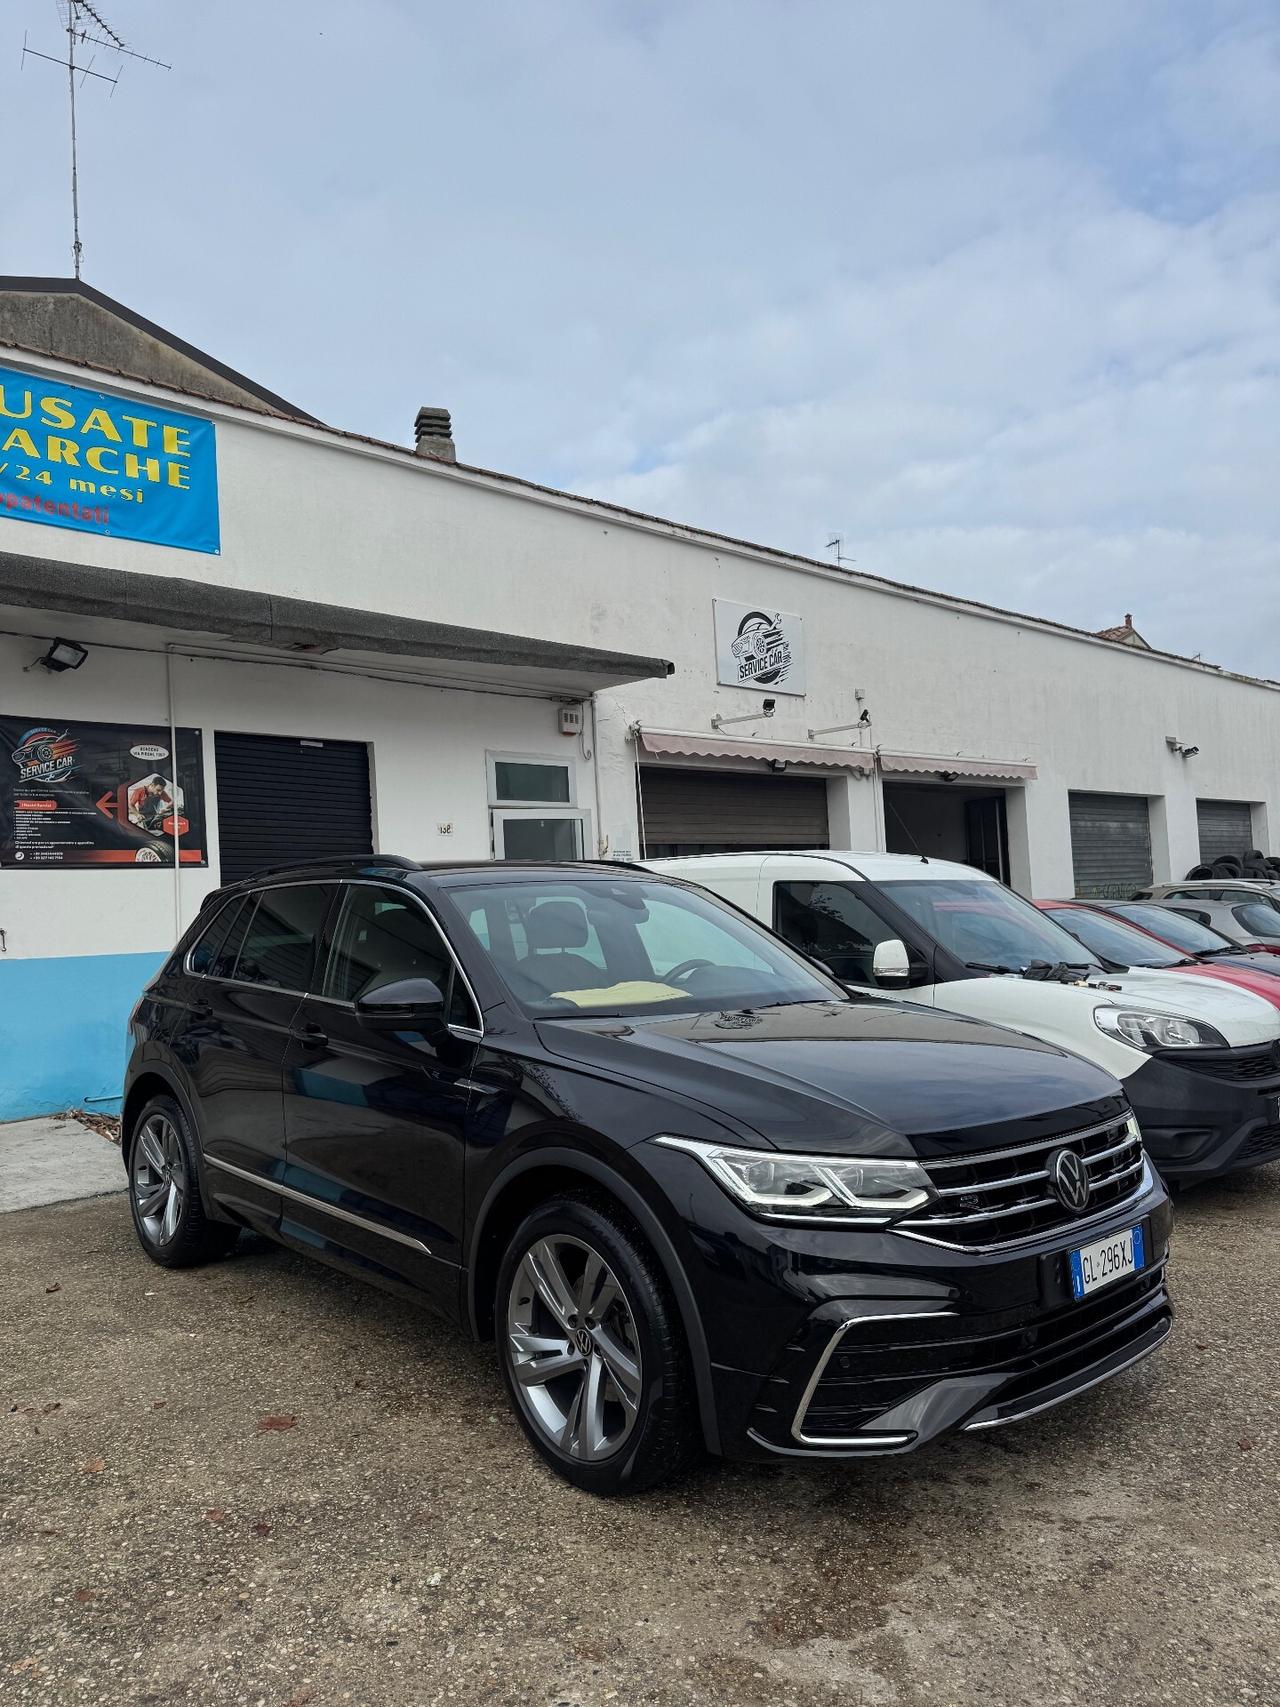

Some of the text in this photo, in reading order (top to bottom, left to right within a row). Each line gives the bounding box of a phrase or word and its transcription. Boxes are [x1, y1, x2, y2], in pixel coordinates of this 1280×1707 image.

[0, 384, 191, 458] USATE
[69, 477, 143, 504] mesi
[740, 650, 783, 679] SERVICE CAR
[20, 756, 73, 779] SERVICE CAR
[1082, 1255, 1097, 1284] GL
[1100, 1237, 1134, 1278] 296XJ
